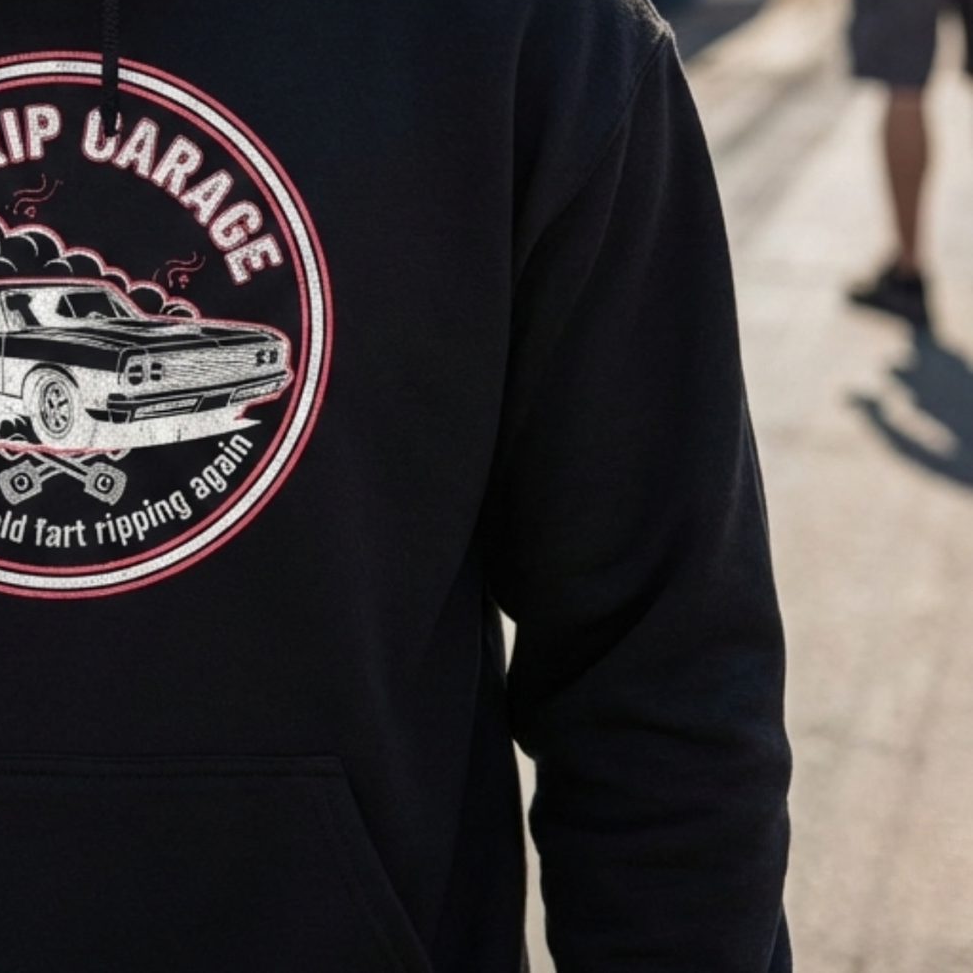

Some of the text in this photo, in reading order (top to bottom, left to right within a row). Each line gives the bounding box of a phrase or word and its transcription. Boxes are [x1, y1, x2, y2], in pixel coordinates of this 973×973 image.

[35, 518, 87, 548] fart
[94, 490, 192, 546] ripping
[189, 434, 253, 500] again
